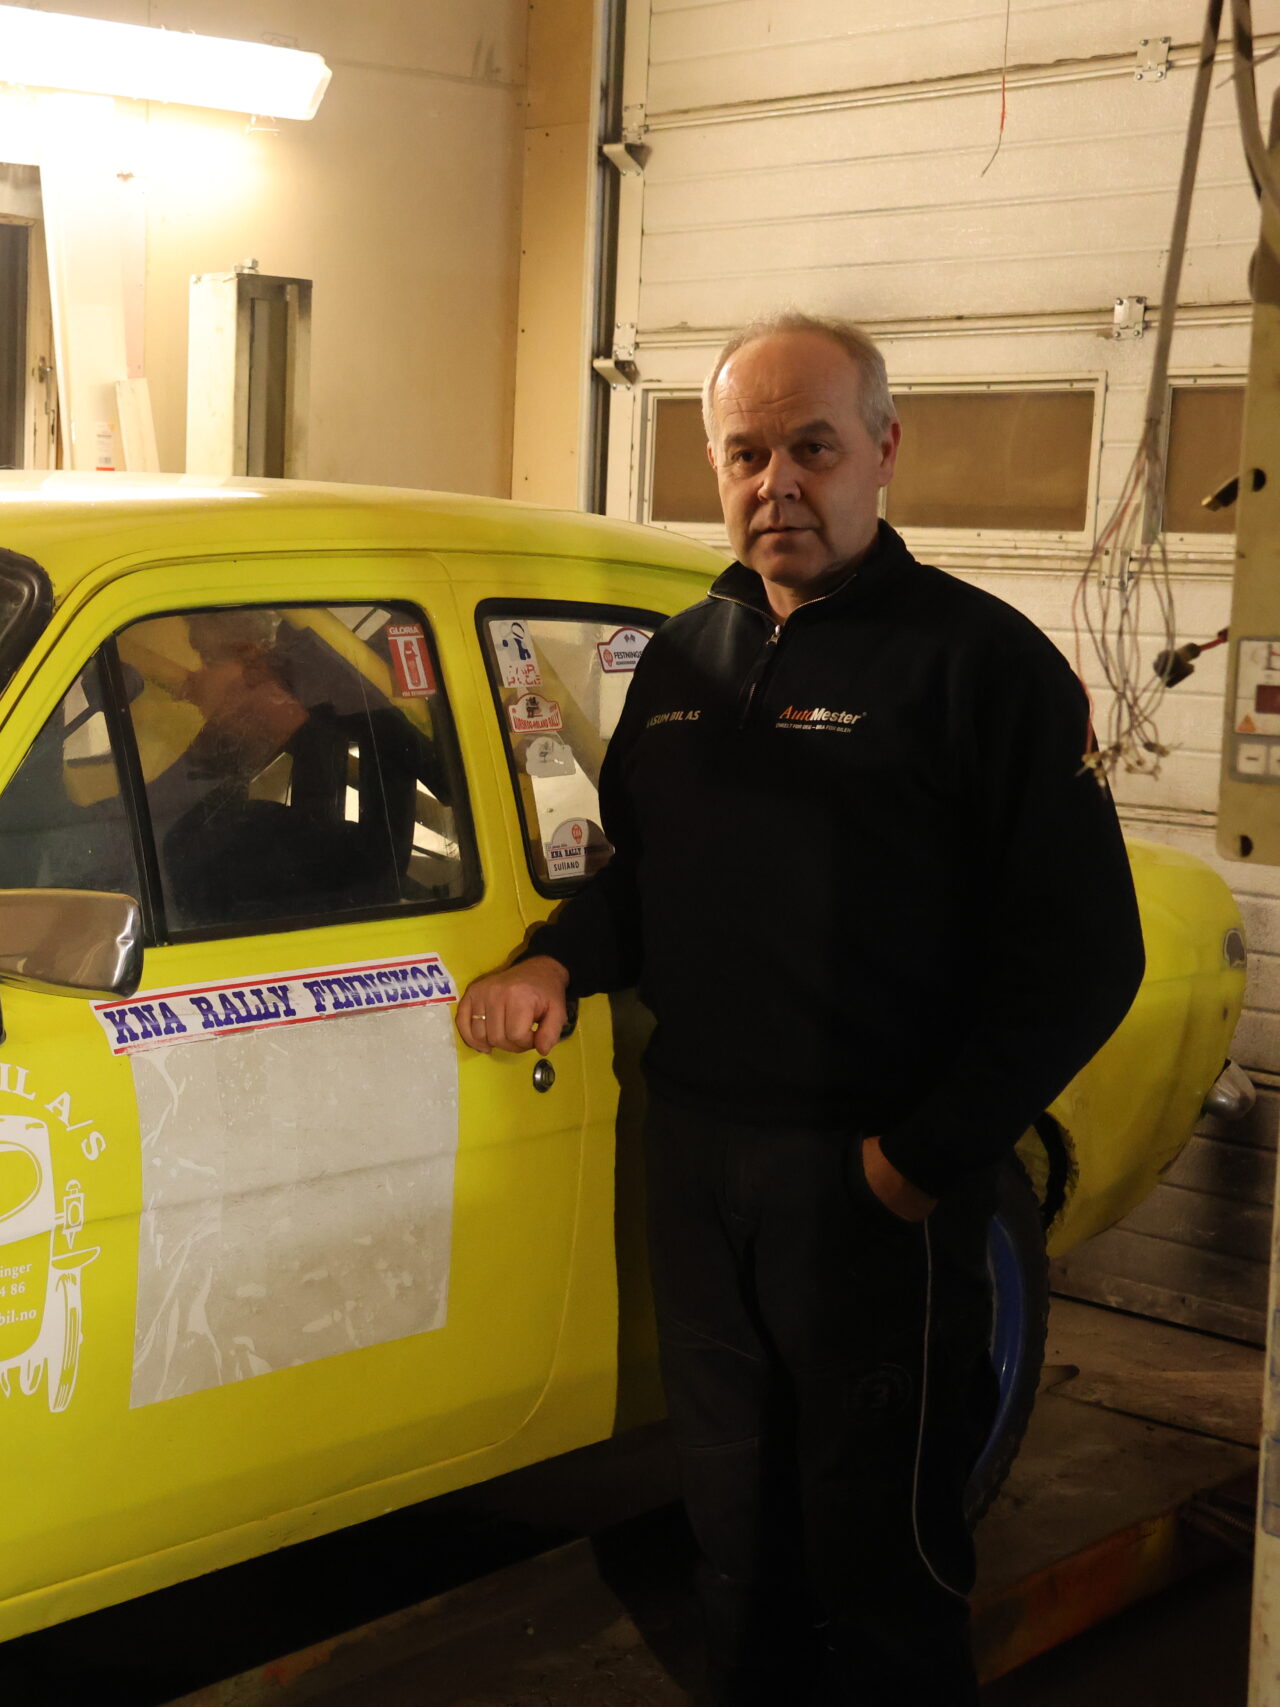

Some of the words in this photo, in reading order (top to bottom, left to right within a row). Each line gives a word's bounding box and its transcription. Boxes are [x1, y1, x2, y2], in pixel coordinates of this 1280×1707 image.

[389, 626, 420, 635] GLORIA
[669, 711, 684, 721] BIL
[685, 710, 701, 720] AS
[779, 705, 861, 724] AutoMester
[565, 848, 581, 857] RALLY
[103, 1001, 187, 1043] KNA
[190, 985, 296, 1029] RALLY
[303, 963, 452, 1011] FINNSKOG
[44, 1091, 107, 1161] A/S
[10, 1282, 26, 1296] 86
